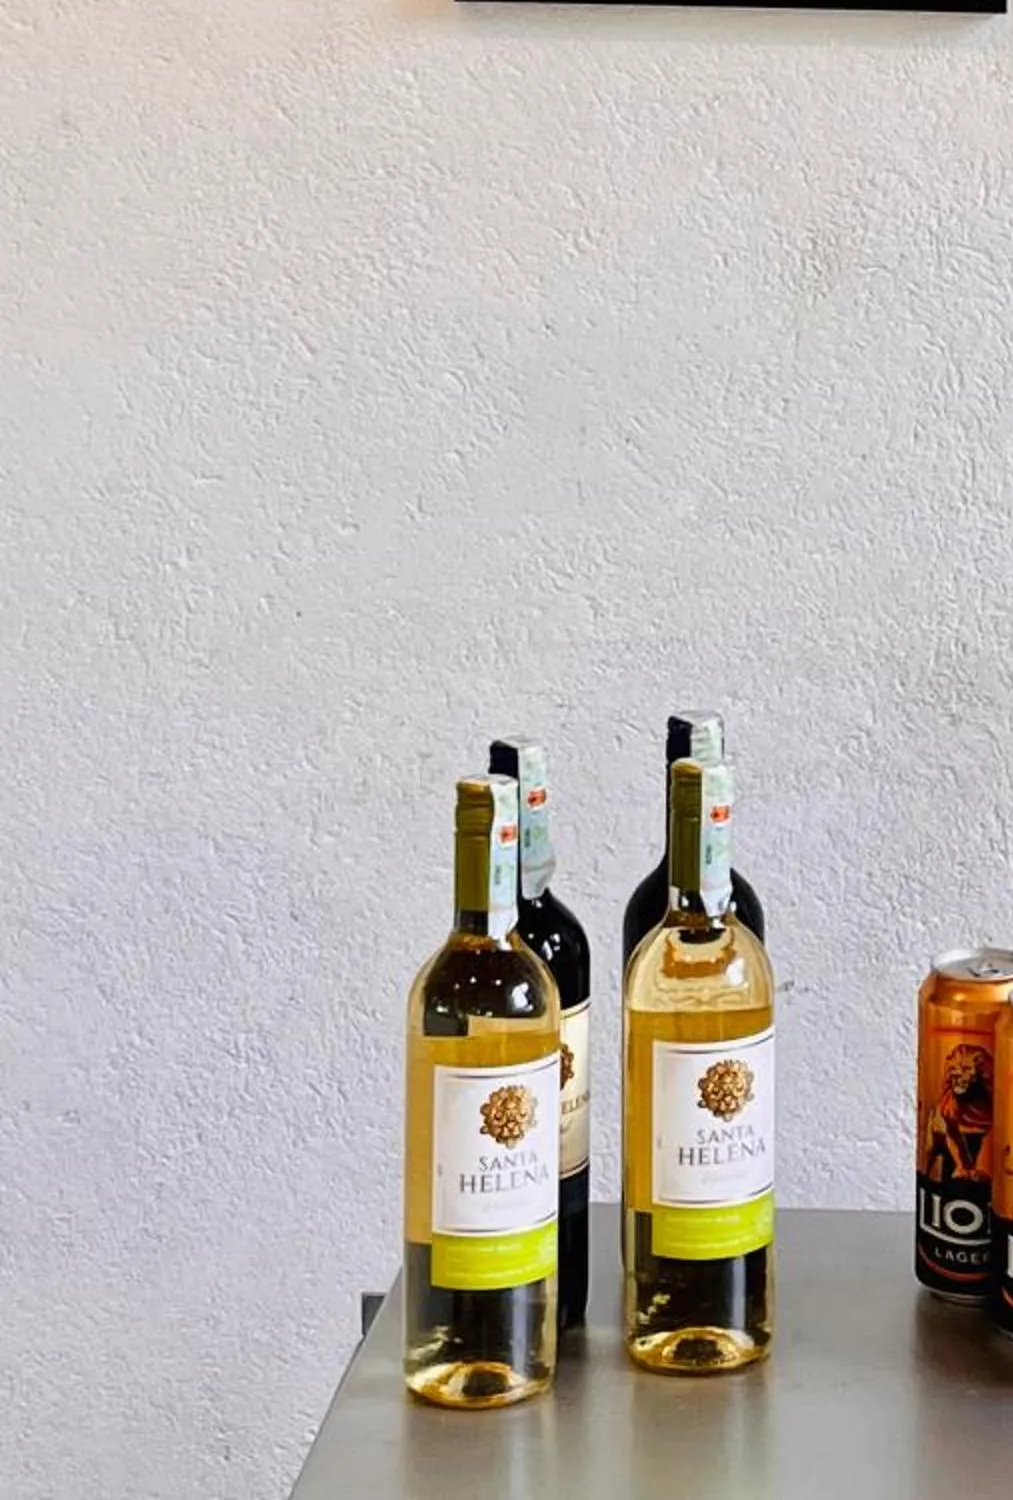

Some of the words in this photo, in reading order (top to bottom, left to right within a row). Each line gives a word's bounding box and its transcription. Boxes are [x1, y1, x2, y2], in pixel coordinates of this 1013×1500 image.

[695, 1123, 755, 1146] SANTA
[478, 1151, 538, 1172] SANTA
[678, 1139, 767, 1167] HELENA
[458, 1163, 551, 1194] HELENA
[919, 1186, 992, 1245] LIO
